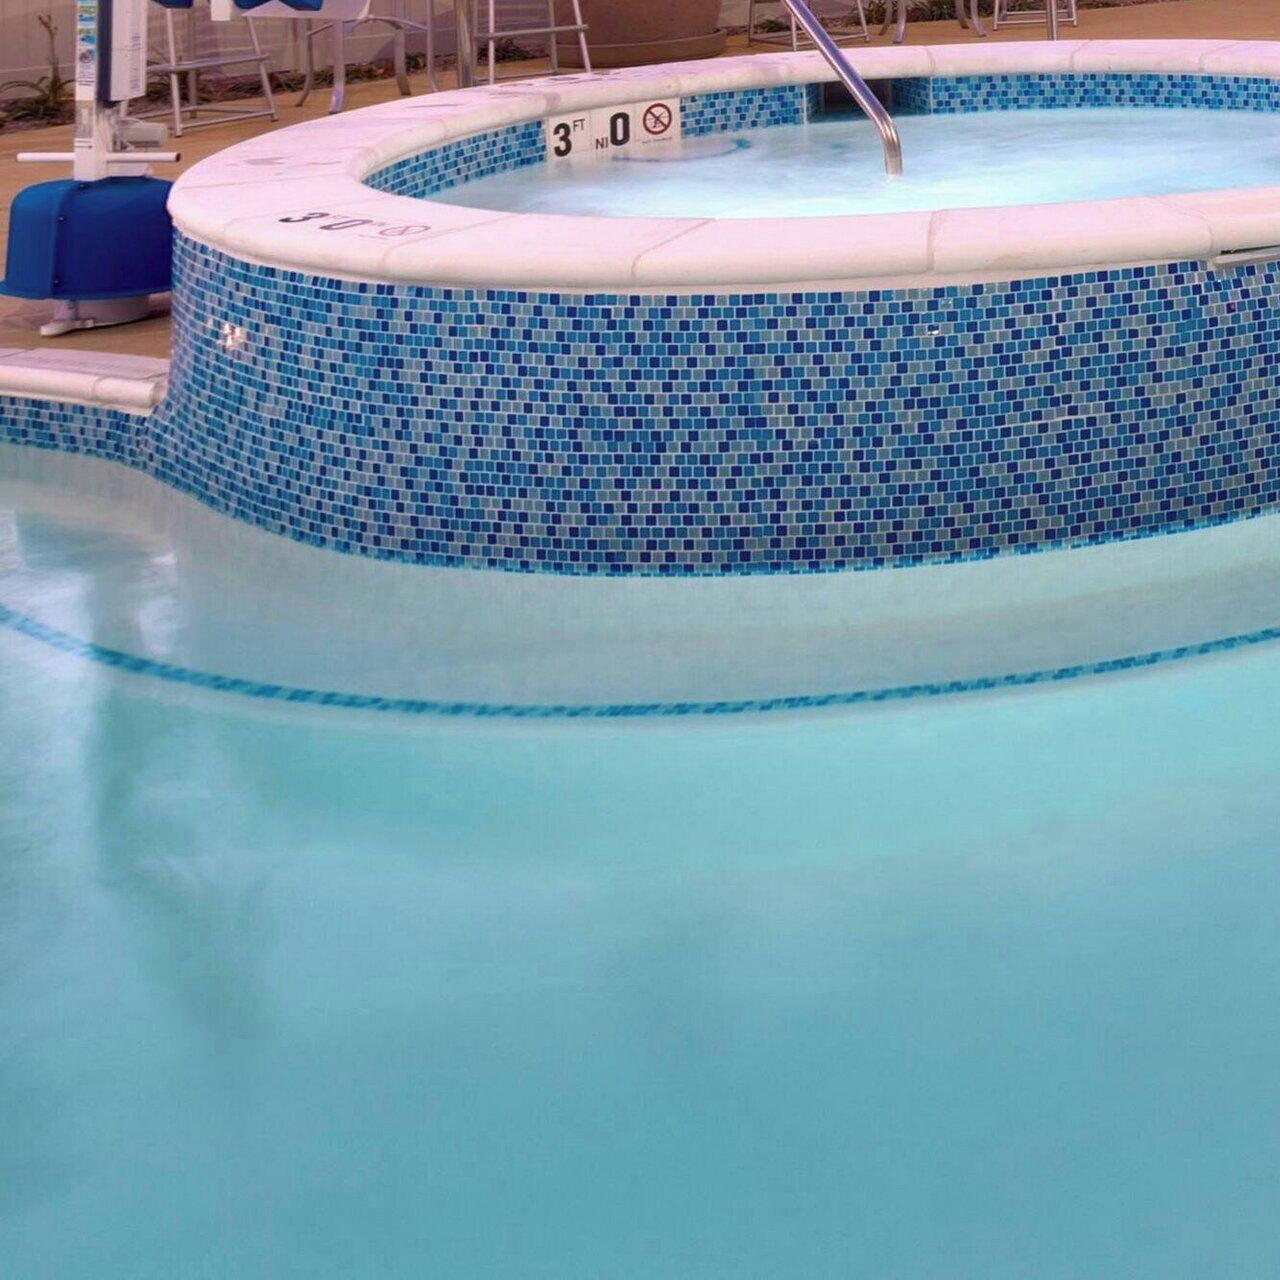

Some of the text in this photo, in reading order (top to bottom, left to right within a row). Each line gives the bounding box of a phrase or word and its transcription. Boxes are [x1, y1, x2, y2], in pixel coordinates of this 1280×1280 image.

[553, 122, 573, 157] 3
[573, 118, 586, 132] FT
[609, 112, 631, 146] 0
